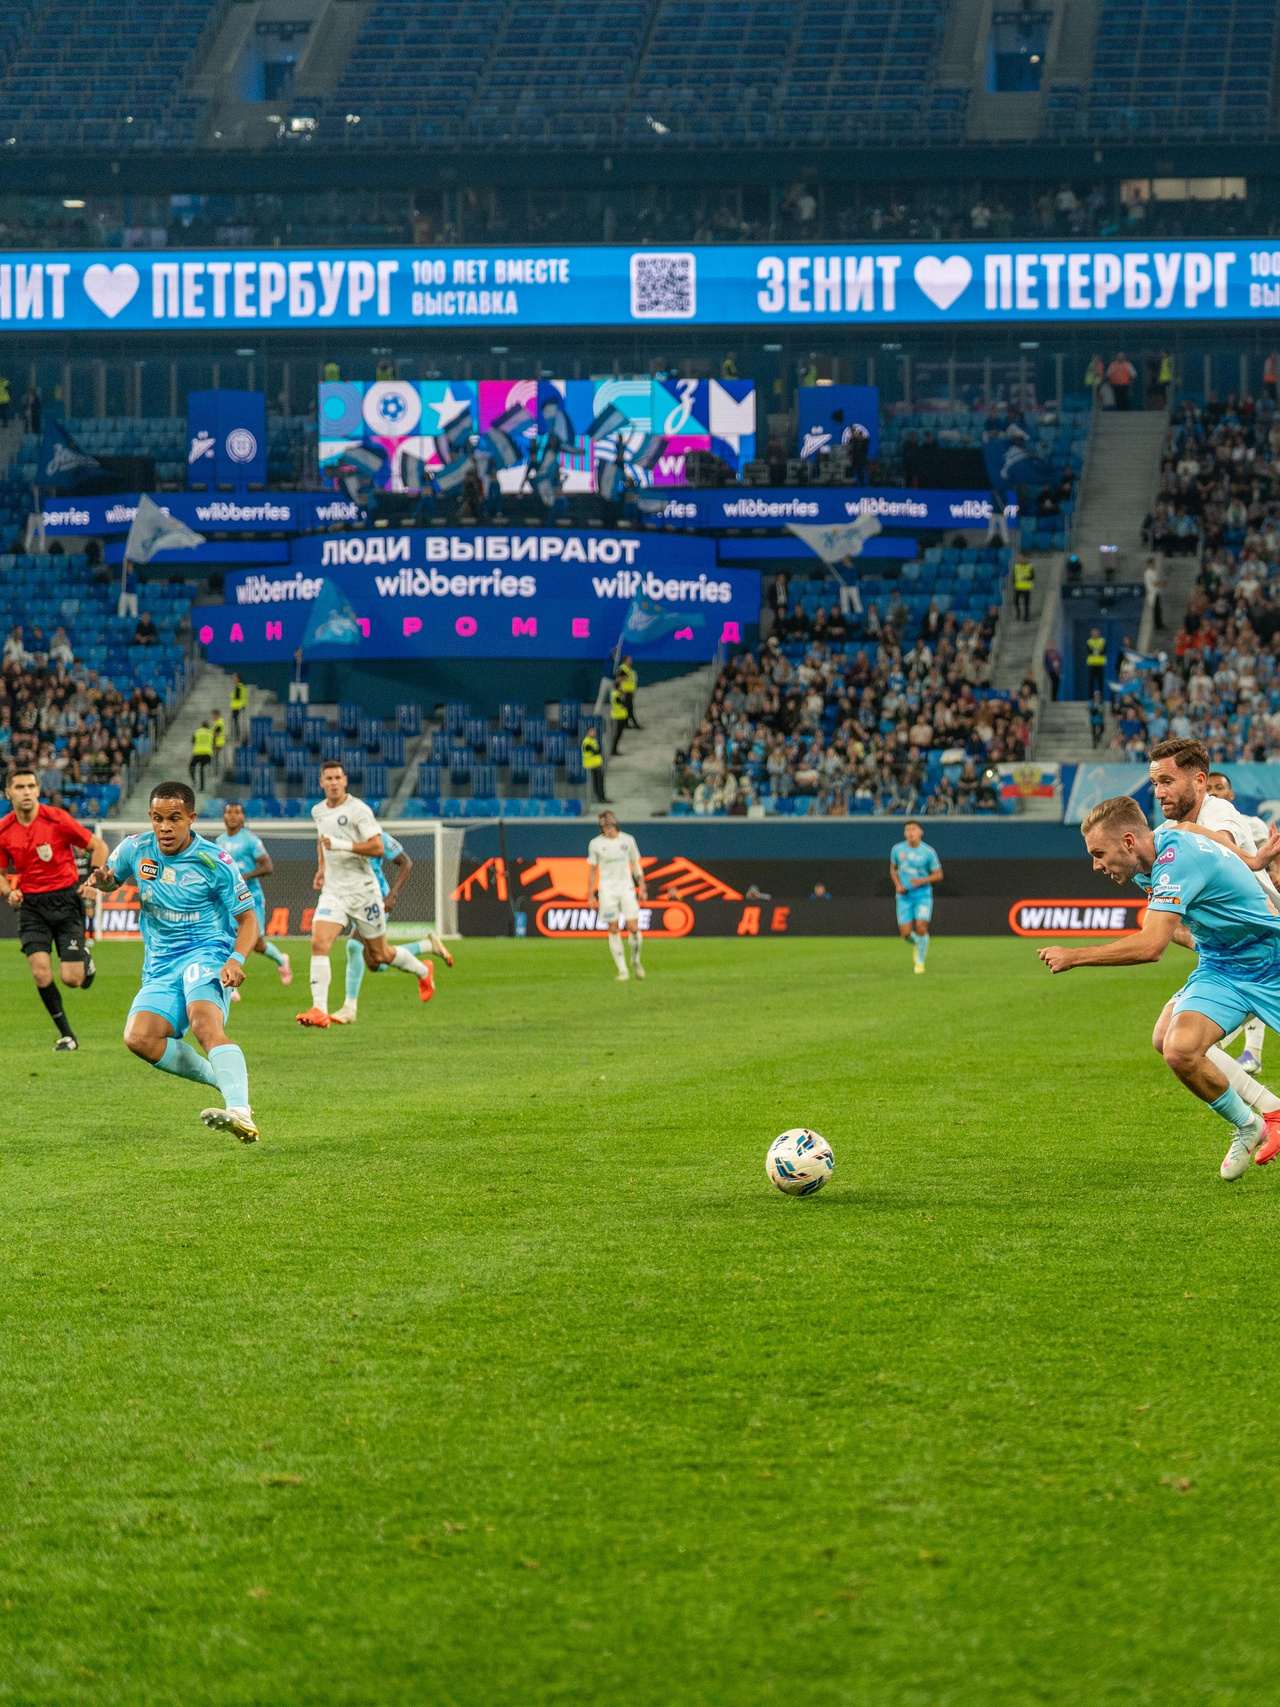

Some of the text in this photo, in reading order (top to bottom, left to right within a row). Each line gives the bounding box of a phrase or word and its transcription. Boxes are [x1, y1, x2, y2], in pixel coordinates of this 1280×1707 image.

[412, 258, 570, 285] 100 ЛЕТ ВМЕСТЕ
[757, 252, 1236, 313] ЗЕНИТ ПЕТЕРБУРГ
[152, 260, 399, 318] ПЕТЕРБУРГ
[411, 290, 518, 316] ВЫСТАВКА
[196, 501, 290, 522] wildberries
[722, 498, 819, 518] wildberries
[322, 536, 641, 567] ЛЮДИ ВЫБИРАЮТ
[374, 567, 538, 598] wildberries
[364, 903, 381, 921] 29
[547, 908, 653, 930] WINLE
[1020, 907, 1128, 930] WINLINE
